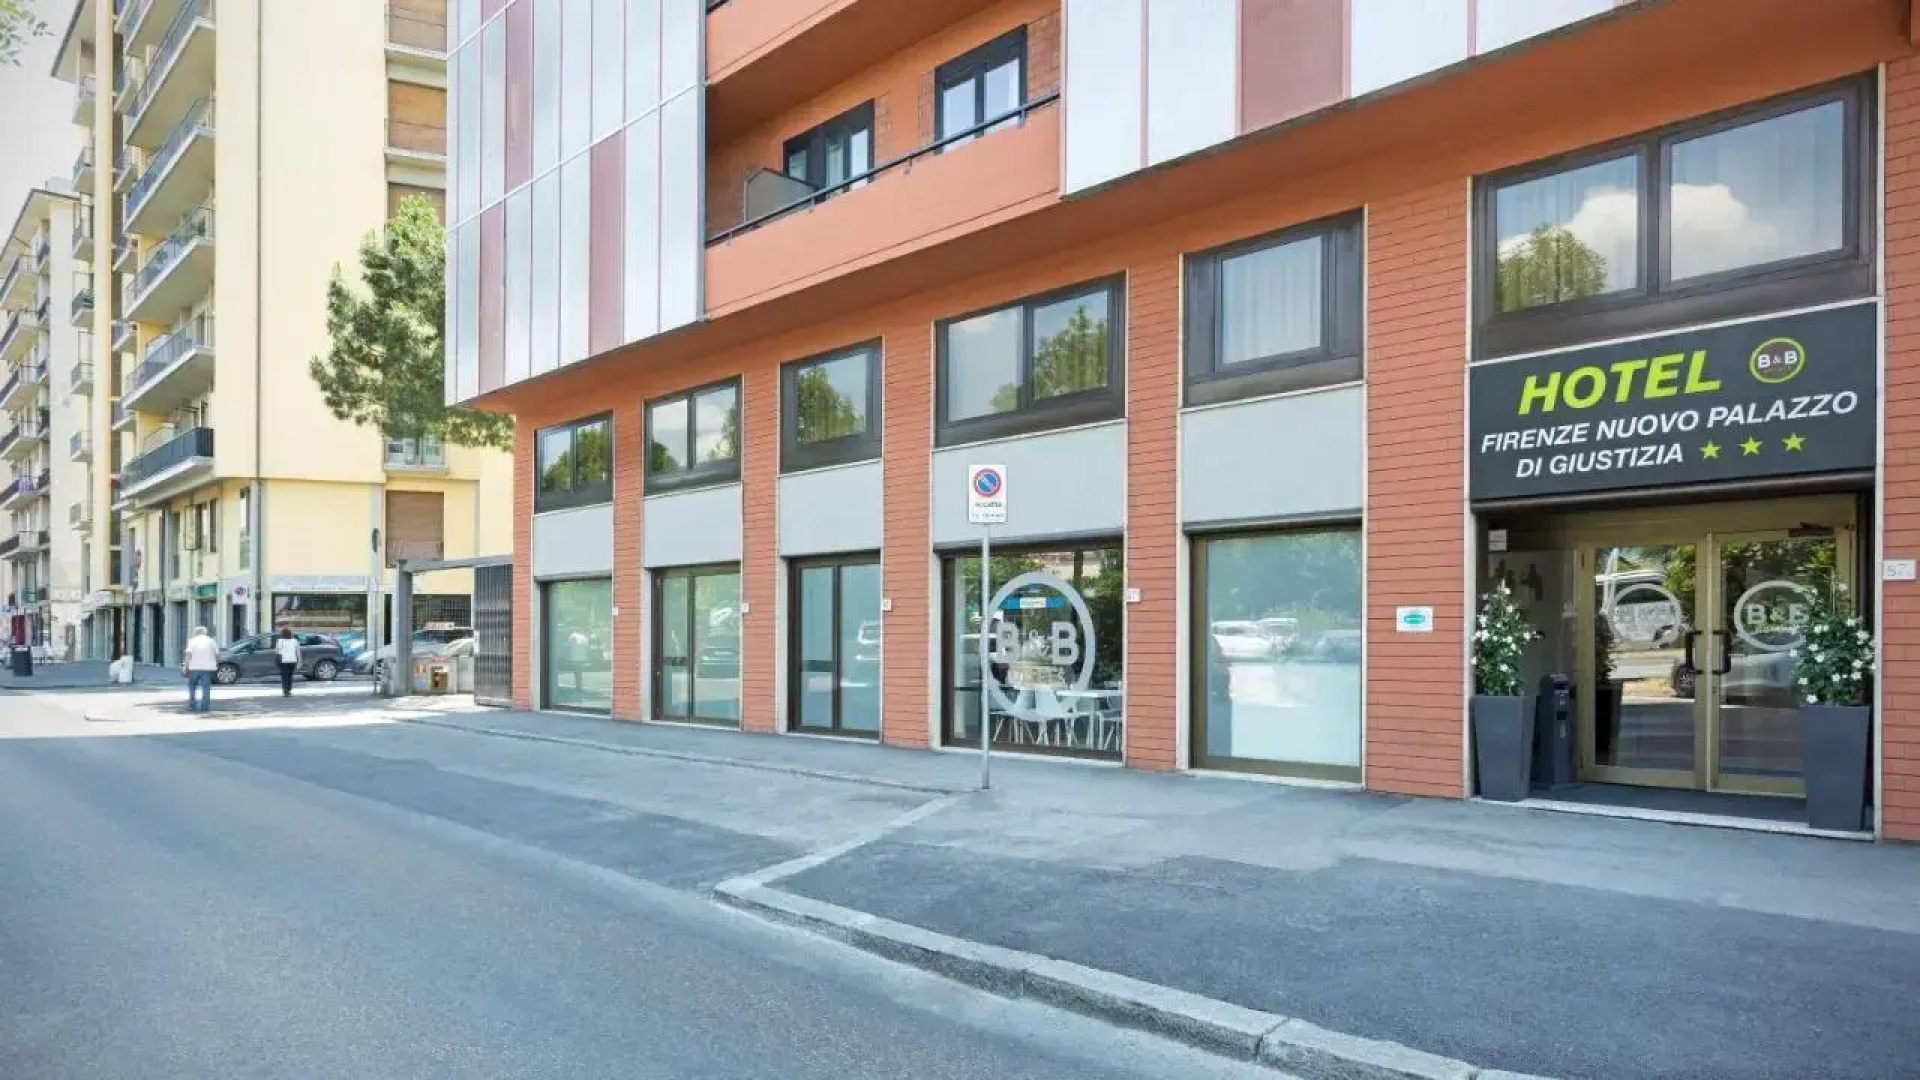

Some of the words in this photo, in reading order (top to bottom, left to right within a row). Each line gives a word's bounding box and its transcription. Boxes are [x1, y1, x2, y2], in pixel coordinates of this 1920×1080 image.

[1517, 350, 1722, 415] HOTEL
[1481, 422, 1591, 453] FIRENZE
[1595, 410, 1699, 441] NUOVO
[1706, 390, 1858, 428] PALAZZO
[1515, 457, 1543, 478] DI
[1549, 443, 1683, 475] GIUSTIZIA
